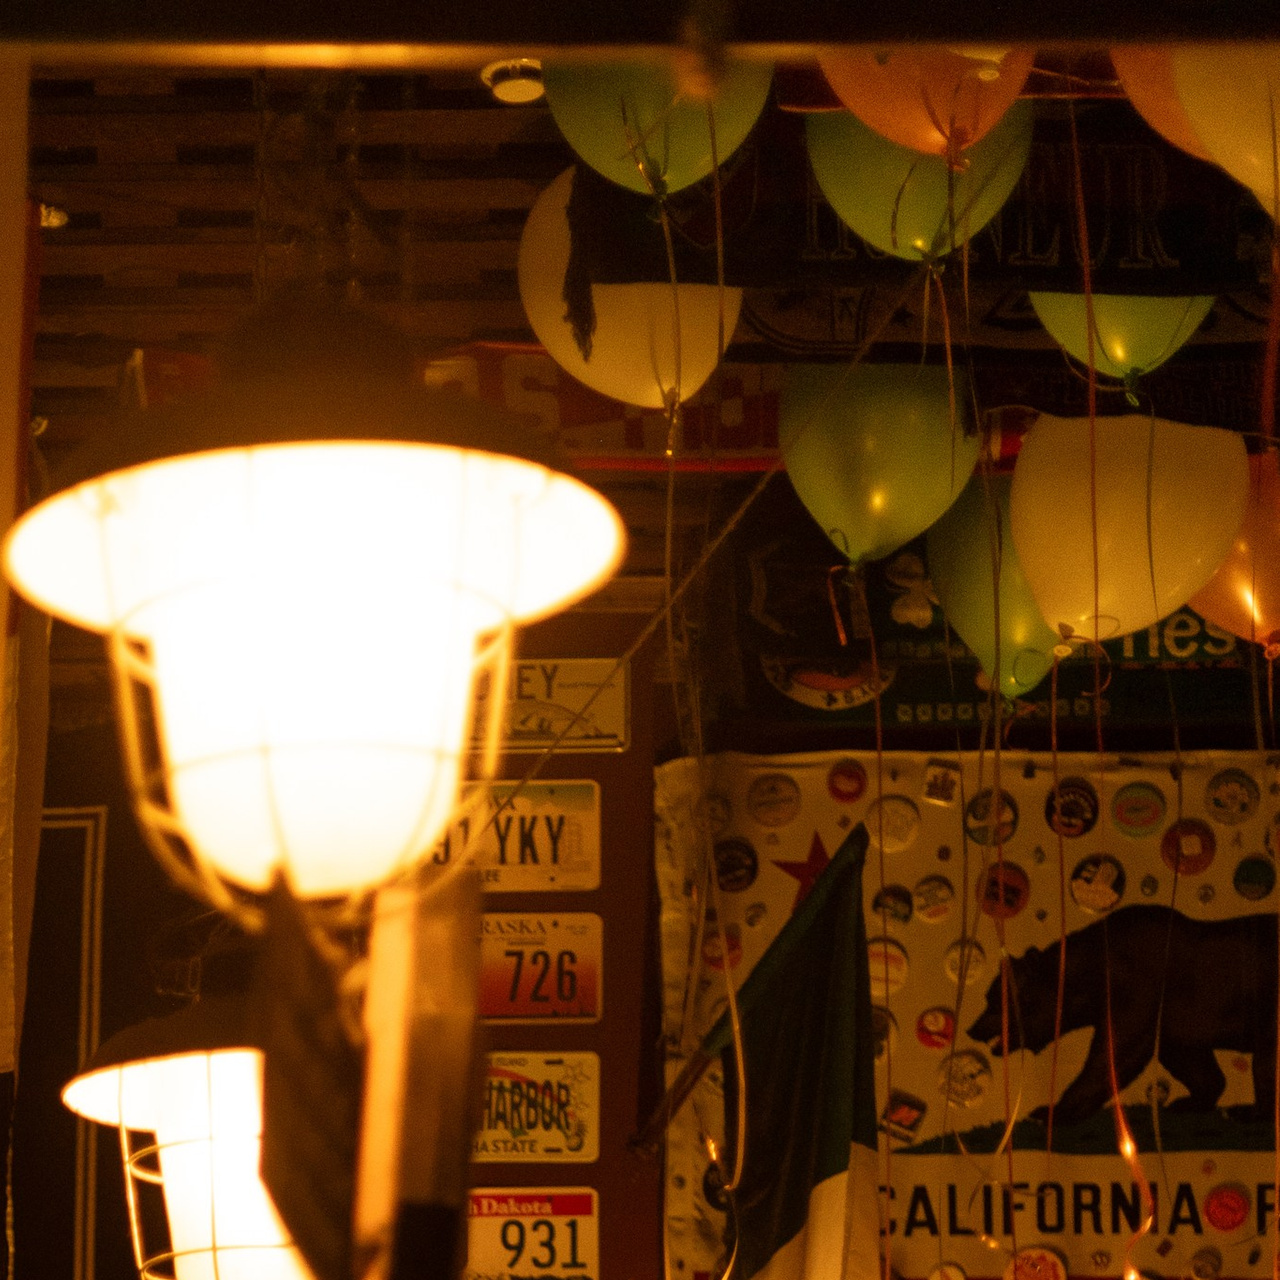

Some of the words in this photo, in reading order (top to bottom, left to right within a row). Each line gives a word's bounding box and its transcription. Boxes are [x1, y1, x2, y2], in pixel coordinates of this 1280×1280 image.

[493, 815, 565, 866] YKY
[504, 950, 577, 1002] 726
[491, 1139, 540, 1153] STATE
[480, 1197, 554, 1214] Dakota
[501, 1219, 588, 1269] 931
